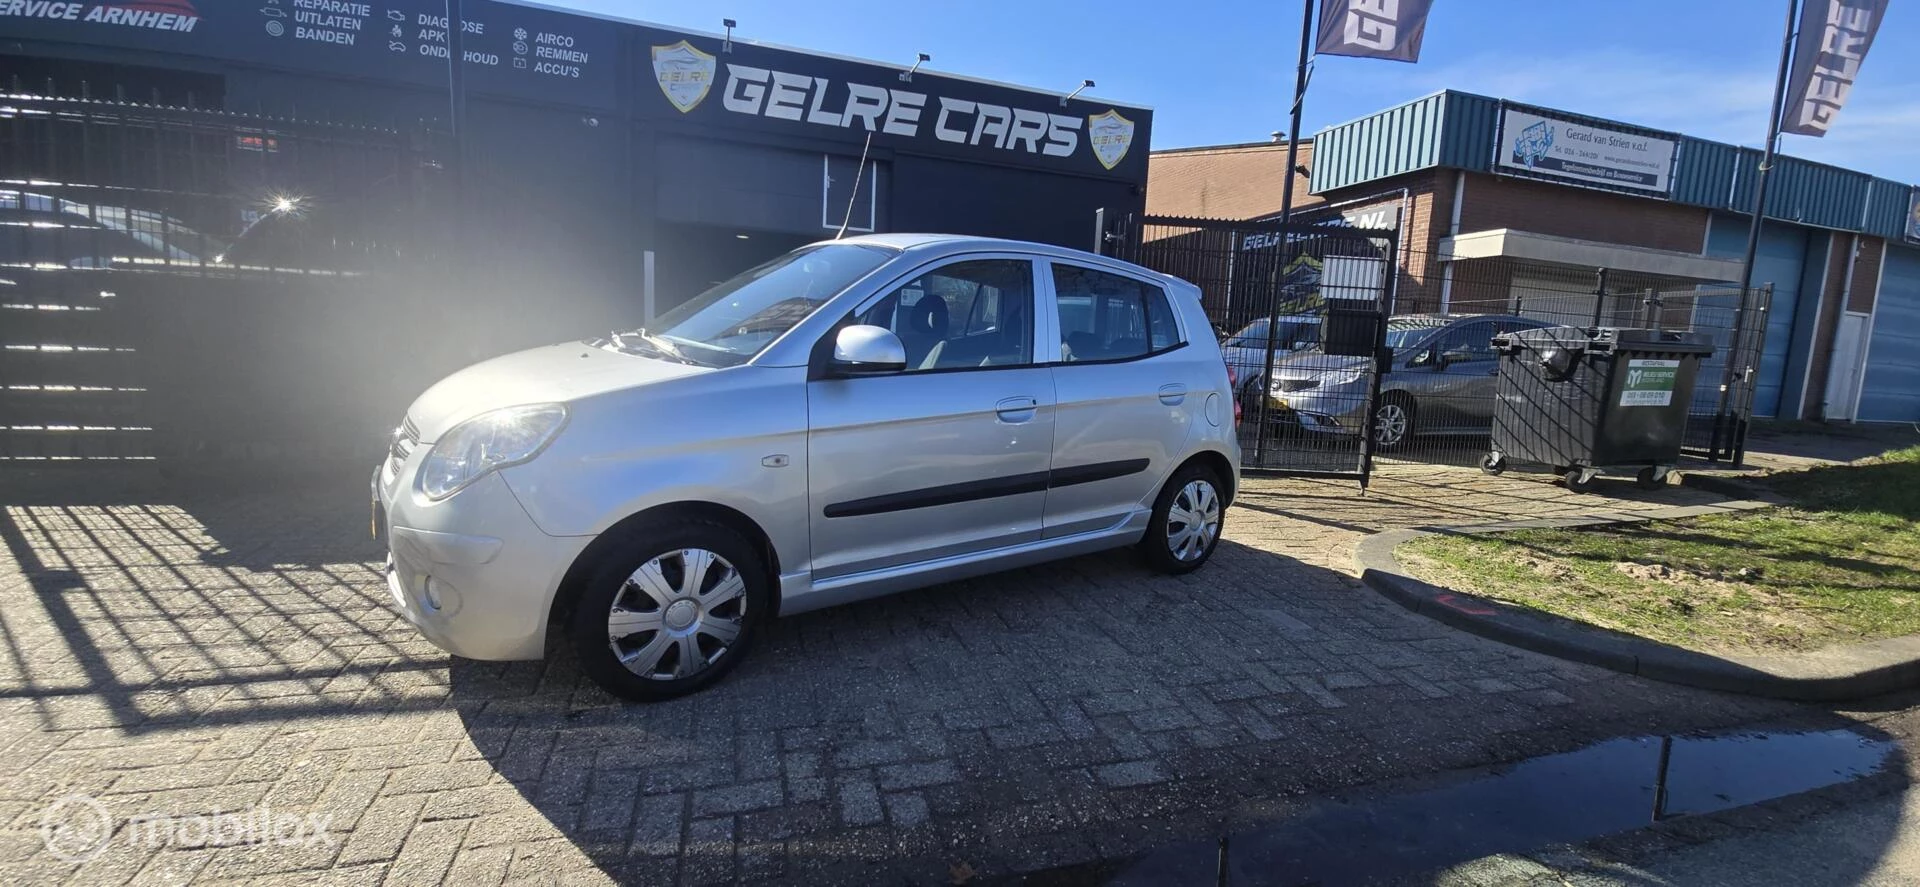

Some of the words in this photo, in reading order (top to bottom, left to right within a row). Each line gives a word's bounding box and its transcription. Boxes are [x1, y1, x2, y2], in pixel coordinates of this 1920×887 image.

[294, 0, 371, 17] REPARATIE
[84, 6, 198, 33] ARNHEM
[295, 10, 361, 31] UITLATEN
[418, 14, 484, 34] DIAGOSE
[295, 26, 355, 46] BANDEN
[418, 29, 445, 43] APK
[535, 32, 574, 48] AIRCO
[536, 46, 589, 64] REMMEN
[534, 62, 580, 79] ACCU'S
[1799, 0, 1871, 131] GELRE
[722, 63, 928, 137] GELRE
[935, 96, 1084, 158] CARS
[1566, 128, 1592, 143] Gerard
[1594, 136, 1607, 145] van
[1609, 136, 1630, 149] Strien
